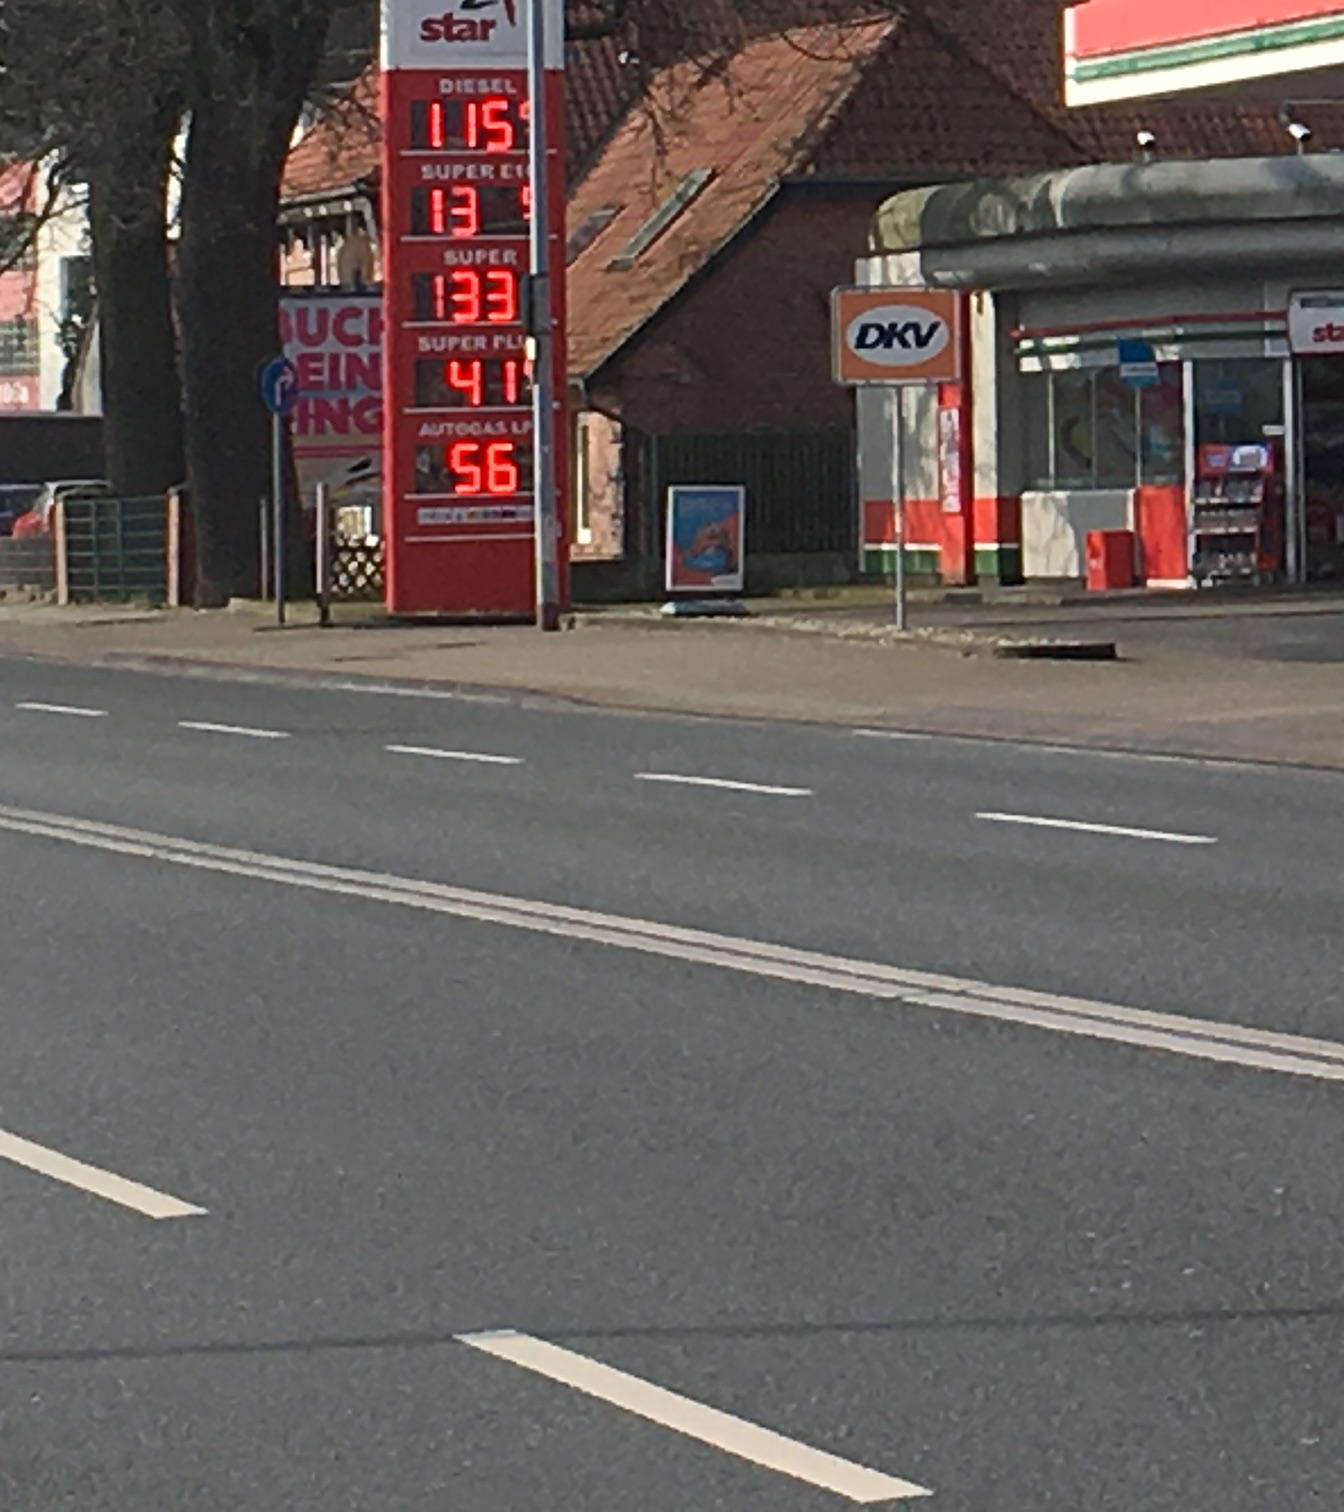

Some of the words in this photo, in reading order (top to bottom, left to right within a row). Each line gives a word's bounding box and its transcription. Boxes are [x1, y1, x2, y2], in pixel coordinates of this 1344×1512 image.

[420, 11, 497, 43] star
[439, 77, 517, 94] DIESEL
[421, 163, 494, 179] SUPER
[443, 249, 517, 265] SUPER
[854, 321, 941, 349] DKV
[418, 336, 487, 352] SUPER
[450, 442, 518, 494] 56
